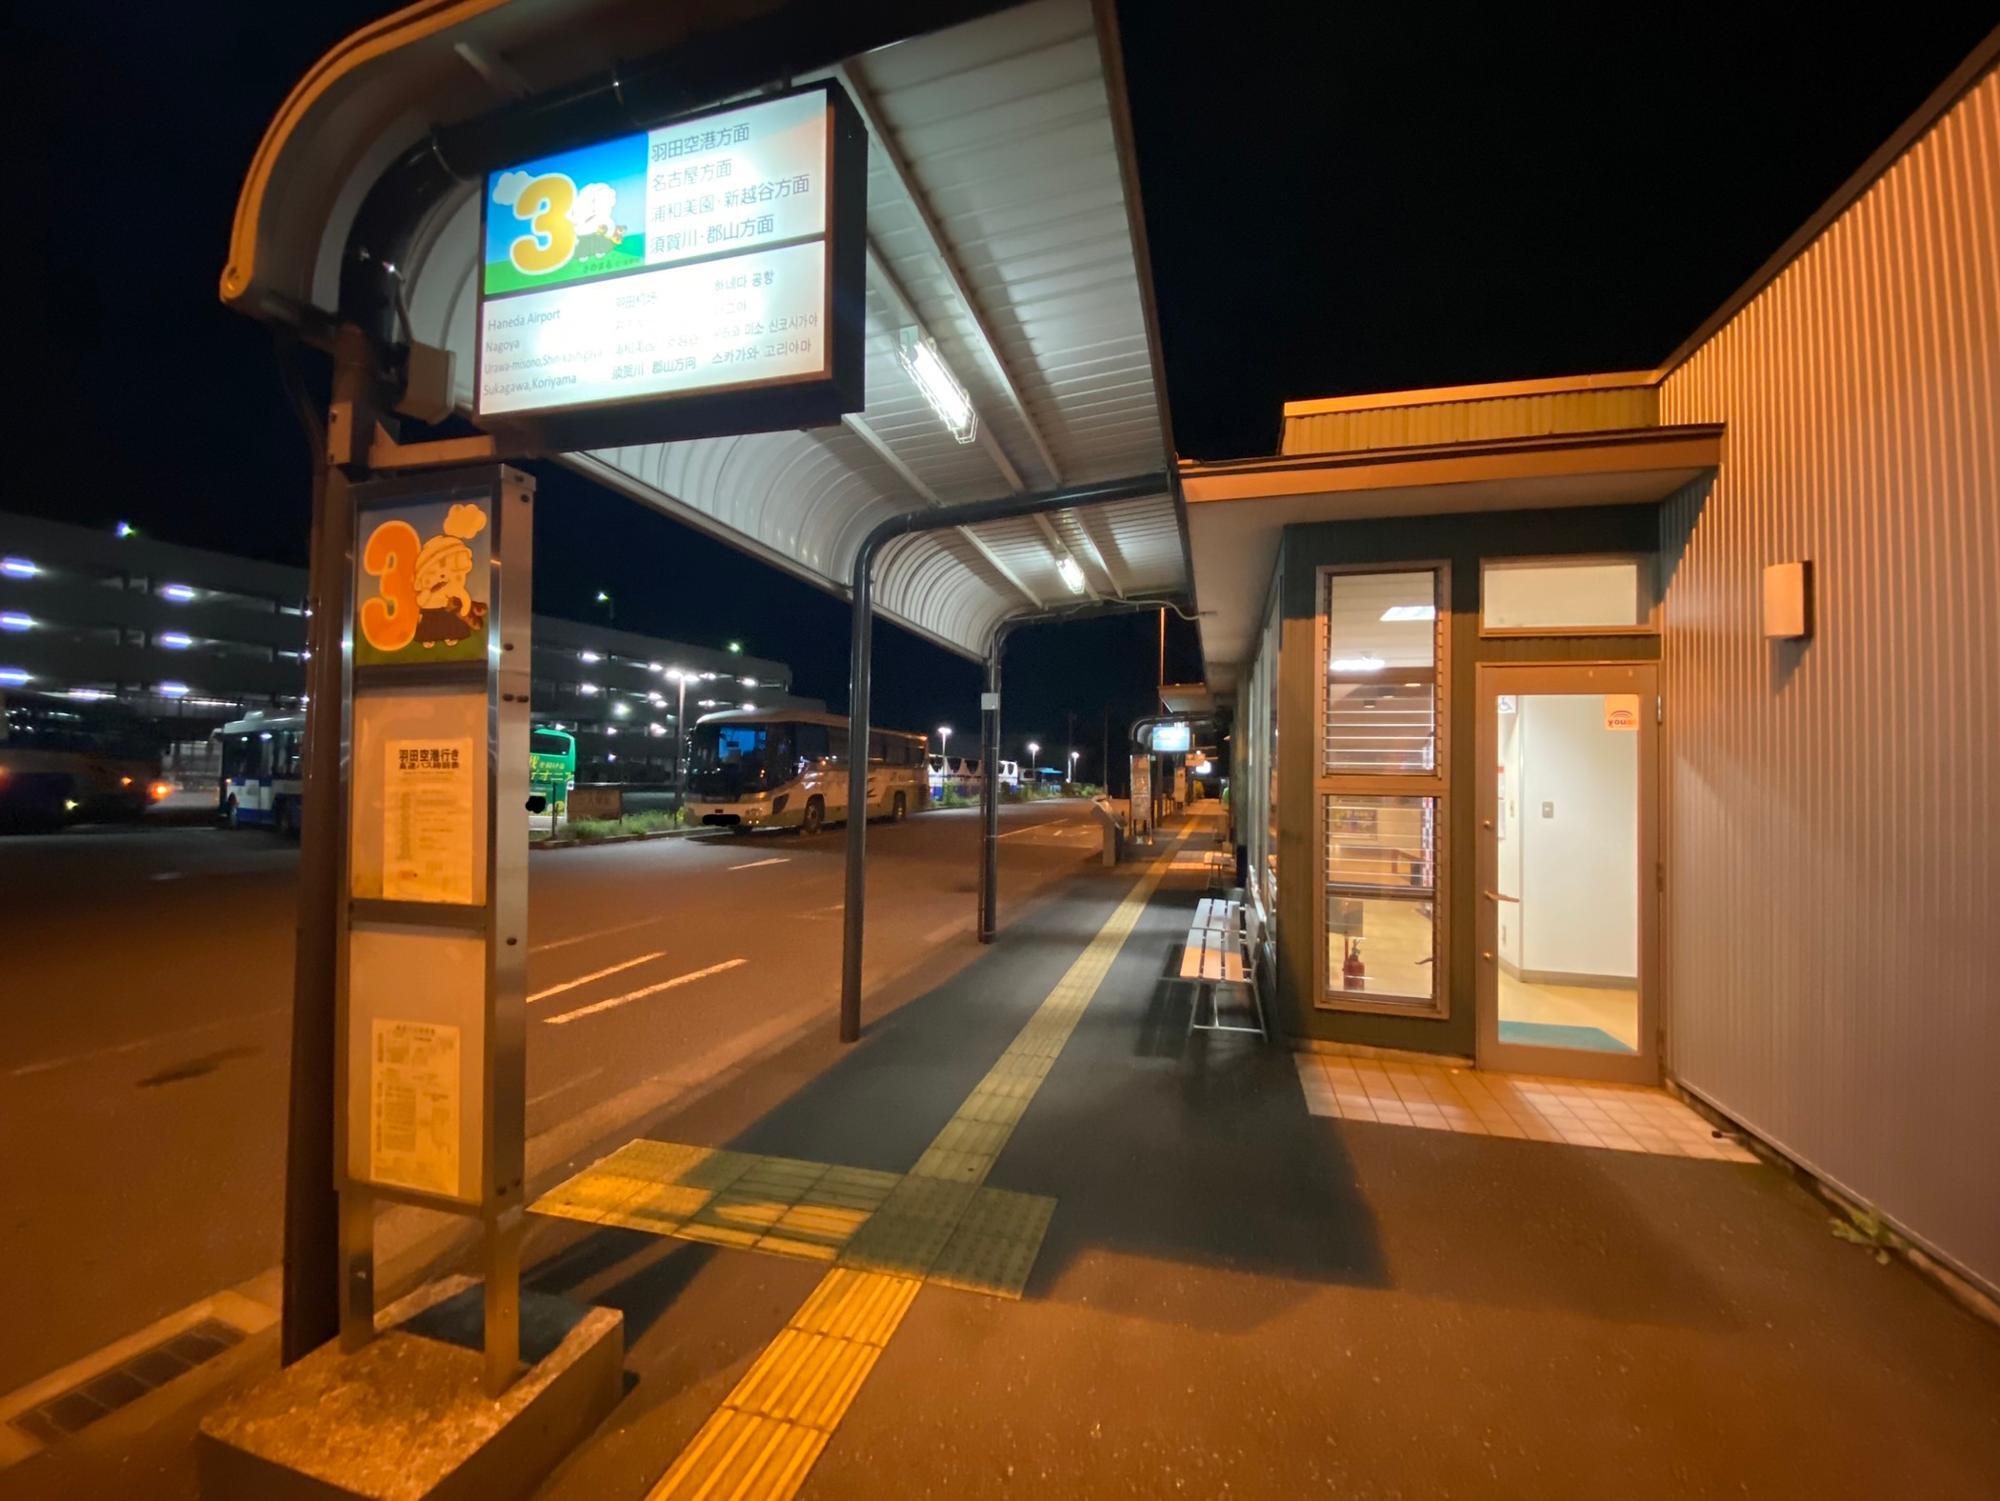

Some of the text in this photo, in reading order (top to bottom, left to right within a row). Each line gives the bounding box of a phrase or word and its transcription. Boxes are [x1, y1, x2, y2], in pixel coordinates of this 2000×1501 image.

[651, 122, 751, 162] 羽田空港方面
[652, 158, 733, 192] 名古屋方面
[511, 174, 577, 275] 3
[751, 269, 775, 288] 공항
[488, 309, 561, 331] Haneda Airport
[486, 339, 520, 353] Nagoya
[361, 520, 422, 652] 3
[399, 748, 459, 763] 羽田空港行き
